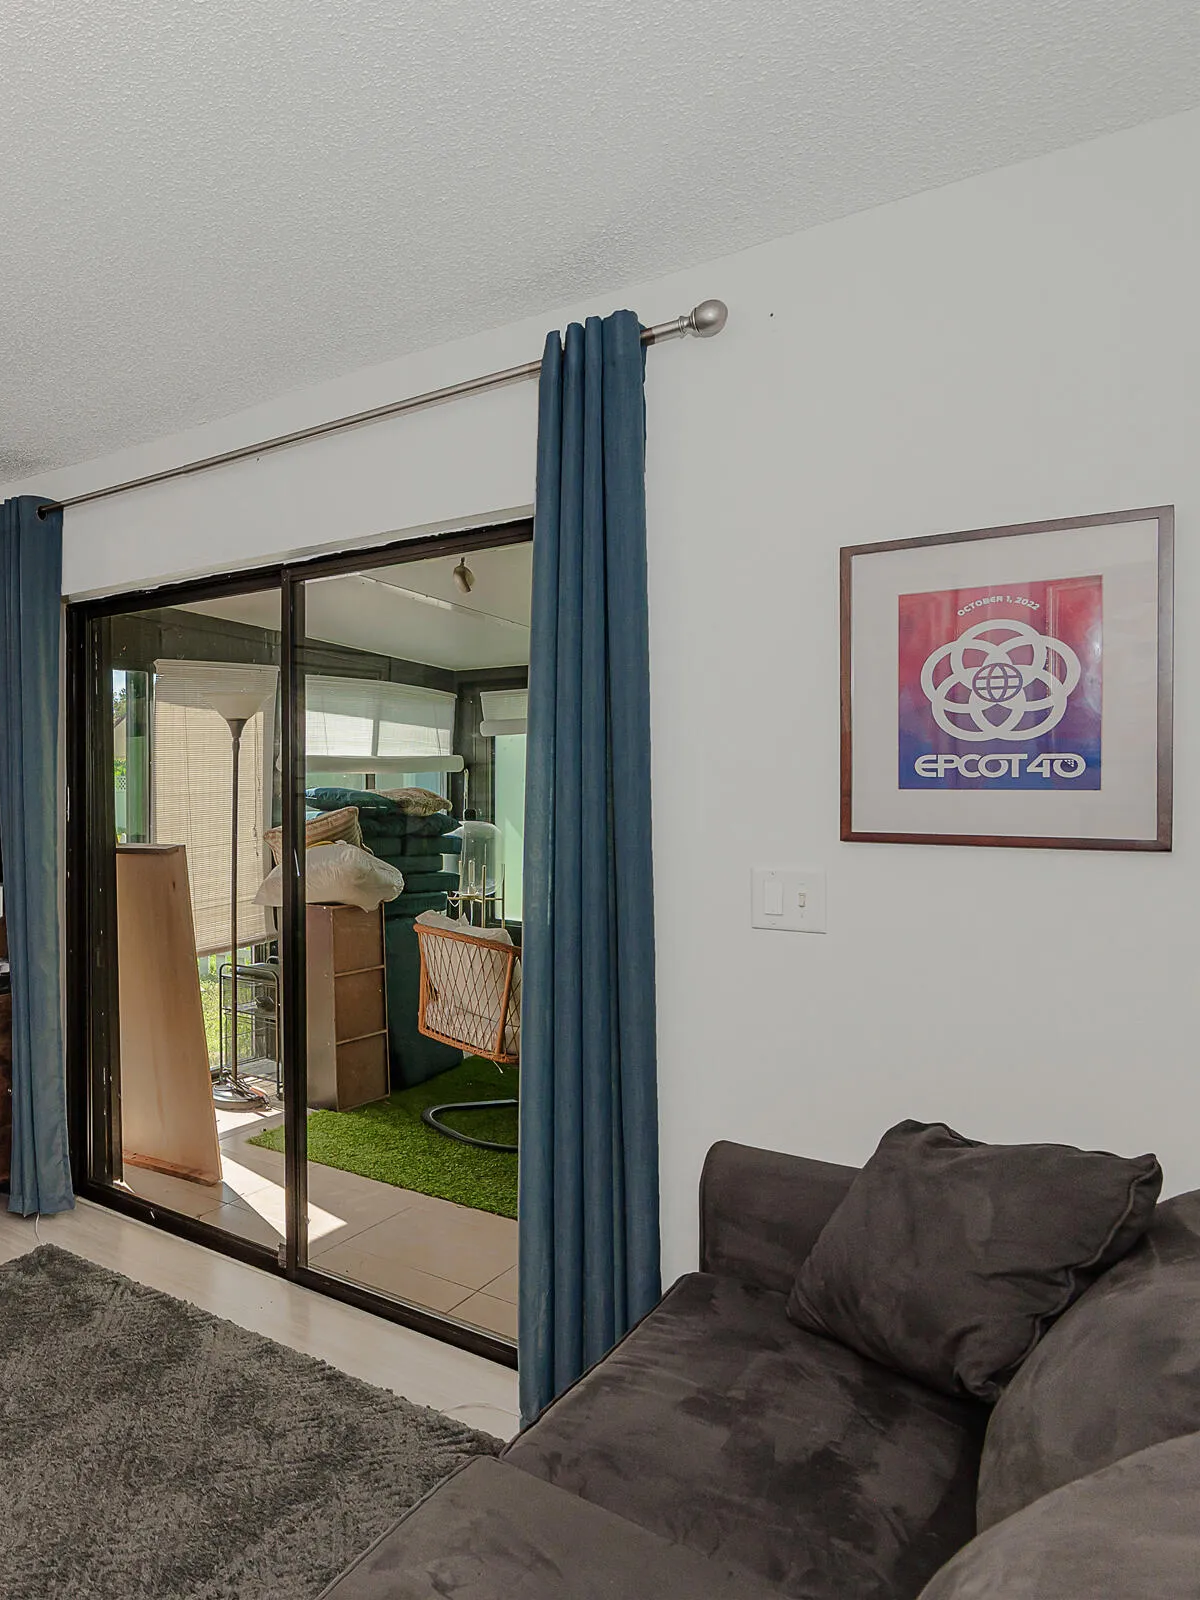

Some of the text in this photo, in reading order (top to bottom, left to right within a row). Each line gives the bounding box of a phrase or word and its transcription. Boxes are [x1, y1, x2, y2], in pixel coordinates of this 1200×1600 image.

[957, 595, 1040, 616] OCTOBER 1, 2022
[914, 753, 1086, 778] EPCOT 40
